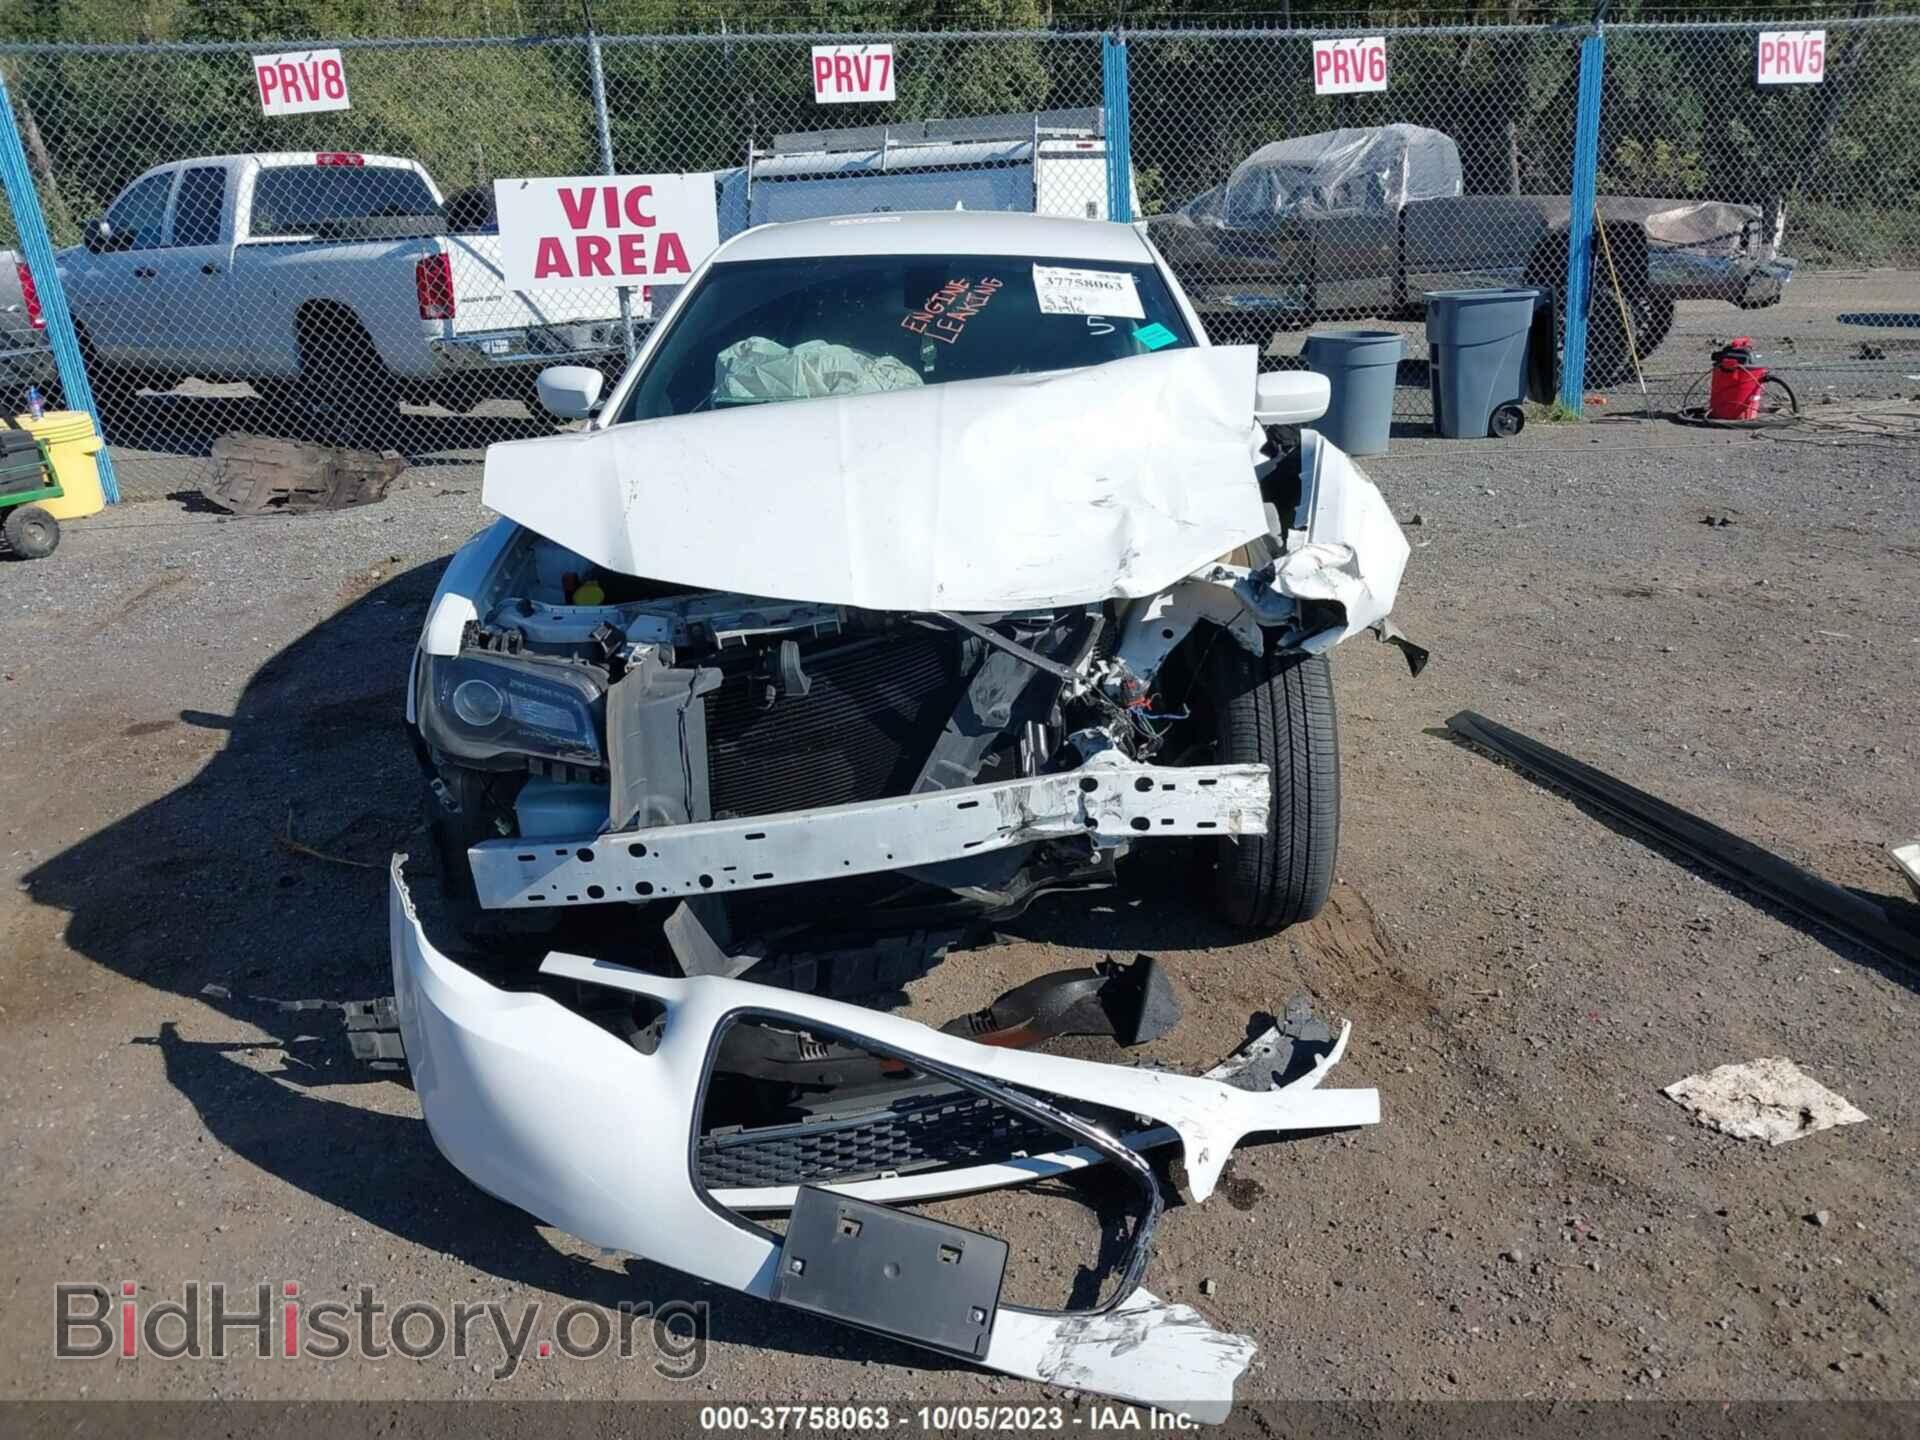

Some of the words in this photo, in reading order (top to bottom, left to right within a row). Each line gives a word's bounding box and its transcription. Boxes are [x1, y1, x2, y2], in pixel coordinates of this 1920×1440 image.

[815, 54, 891, 93] PRV7
[1316, 47, 1385, 85] PRV6
[1761, 40, 1823, 75] PRV5
[257, 59, 345, 105] PRV8
[557, 184, 657, 230] VIC
[534, 232, 692, 279] AREA
[1046, 276, 1124, 291] 37758063
[901, 278, 970, 334] ENGINE
[924, 277, 1004, 345] LEAKING
[1086, 315, 1116, 336] 5
